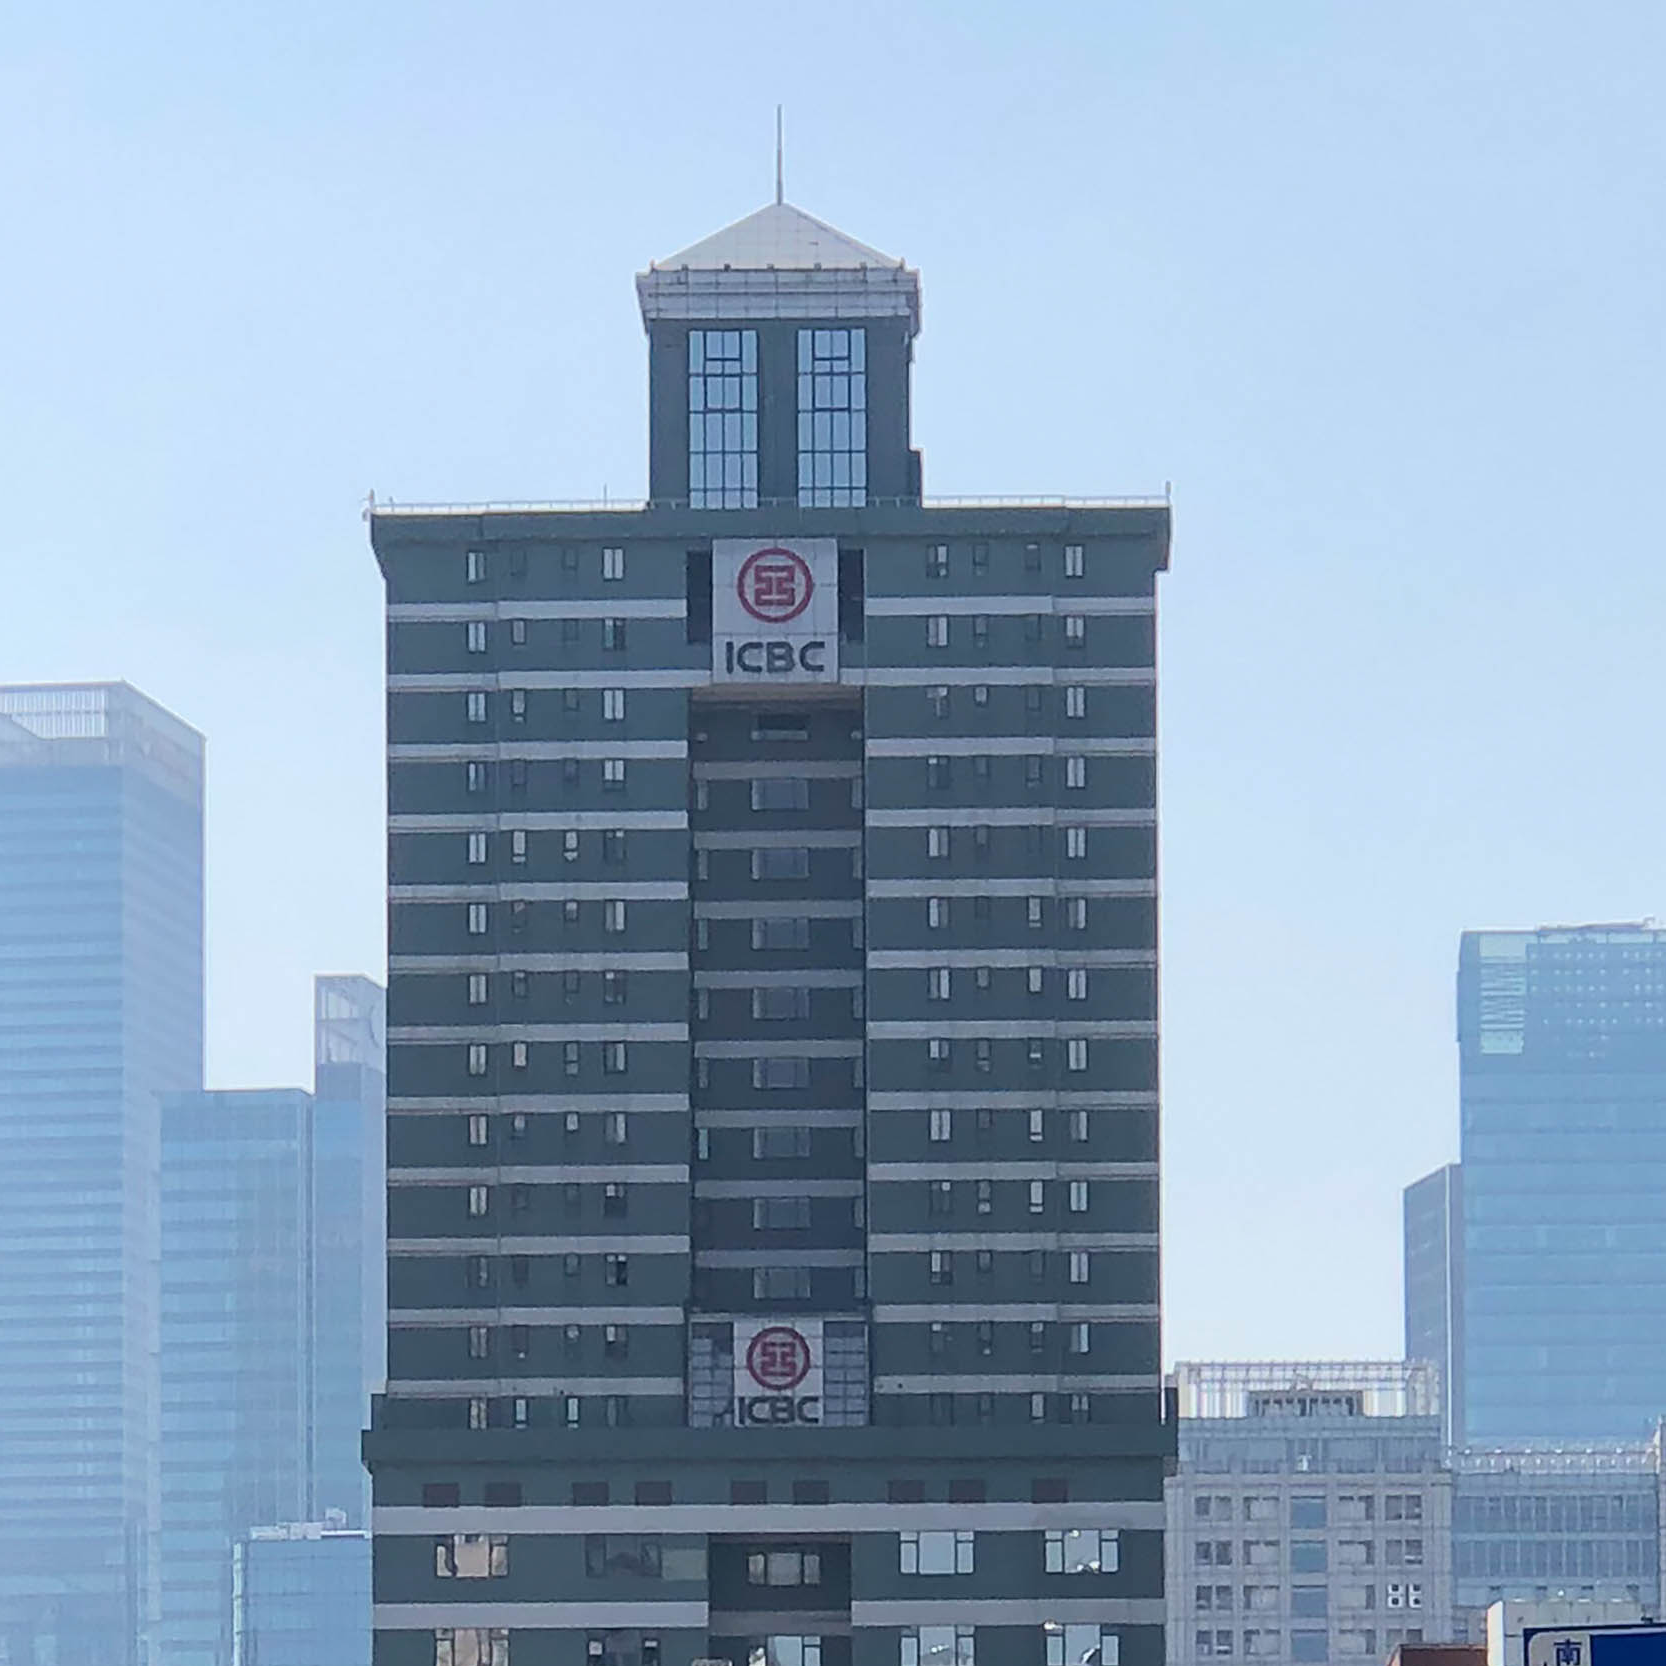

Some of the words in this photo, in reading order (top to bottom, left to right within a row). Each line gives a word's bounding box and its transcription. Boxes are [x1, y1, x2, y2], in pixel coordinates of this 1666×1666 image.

[725, 640, 826, 675] ICBC
[739, 1396, 820, 1425] ICBC
[1554, 1638, 1582, 1666] 南
